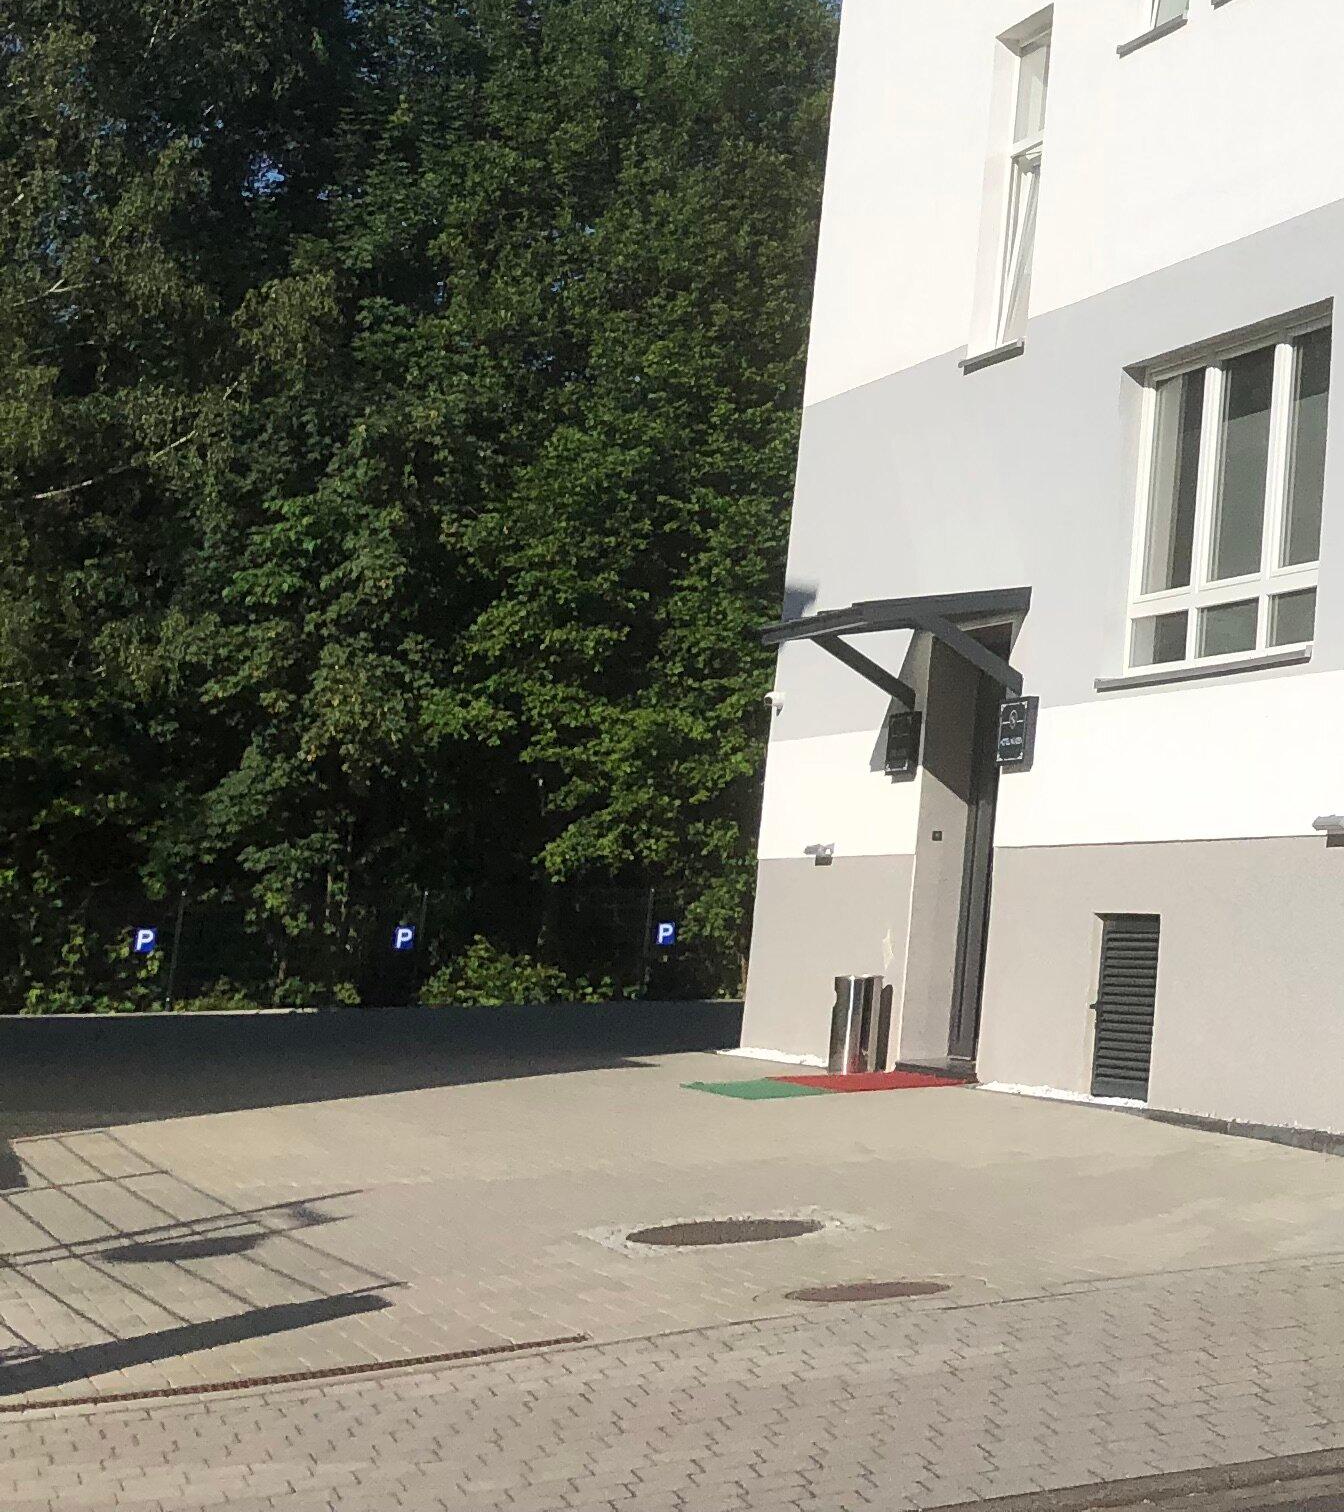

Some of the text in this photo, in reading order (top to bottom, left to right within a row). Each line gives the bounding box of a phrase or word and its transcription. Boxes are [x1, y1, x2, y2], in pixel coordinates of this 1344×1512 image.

[136, 929, 154, 951] P
[396, 928, 413, 949] P
[658, 923, 673, 944] P
